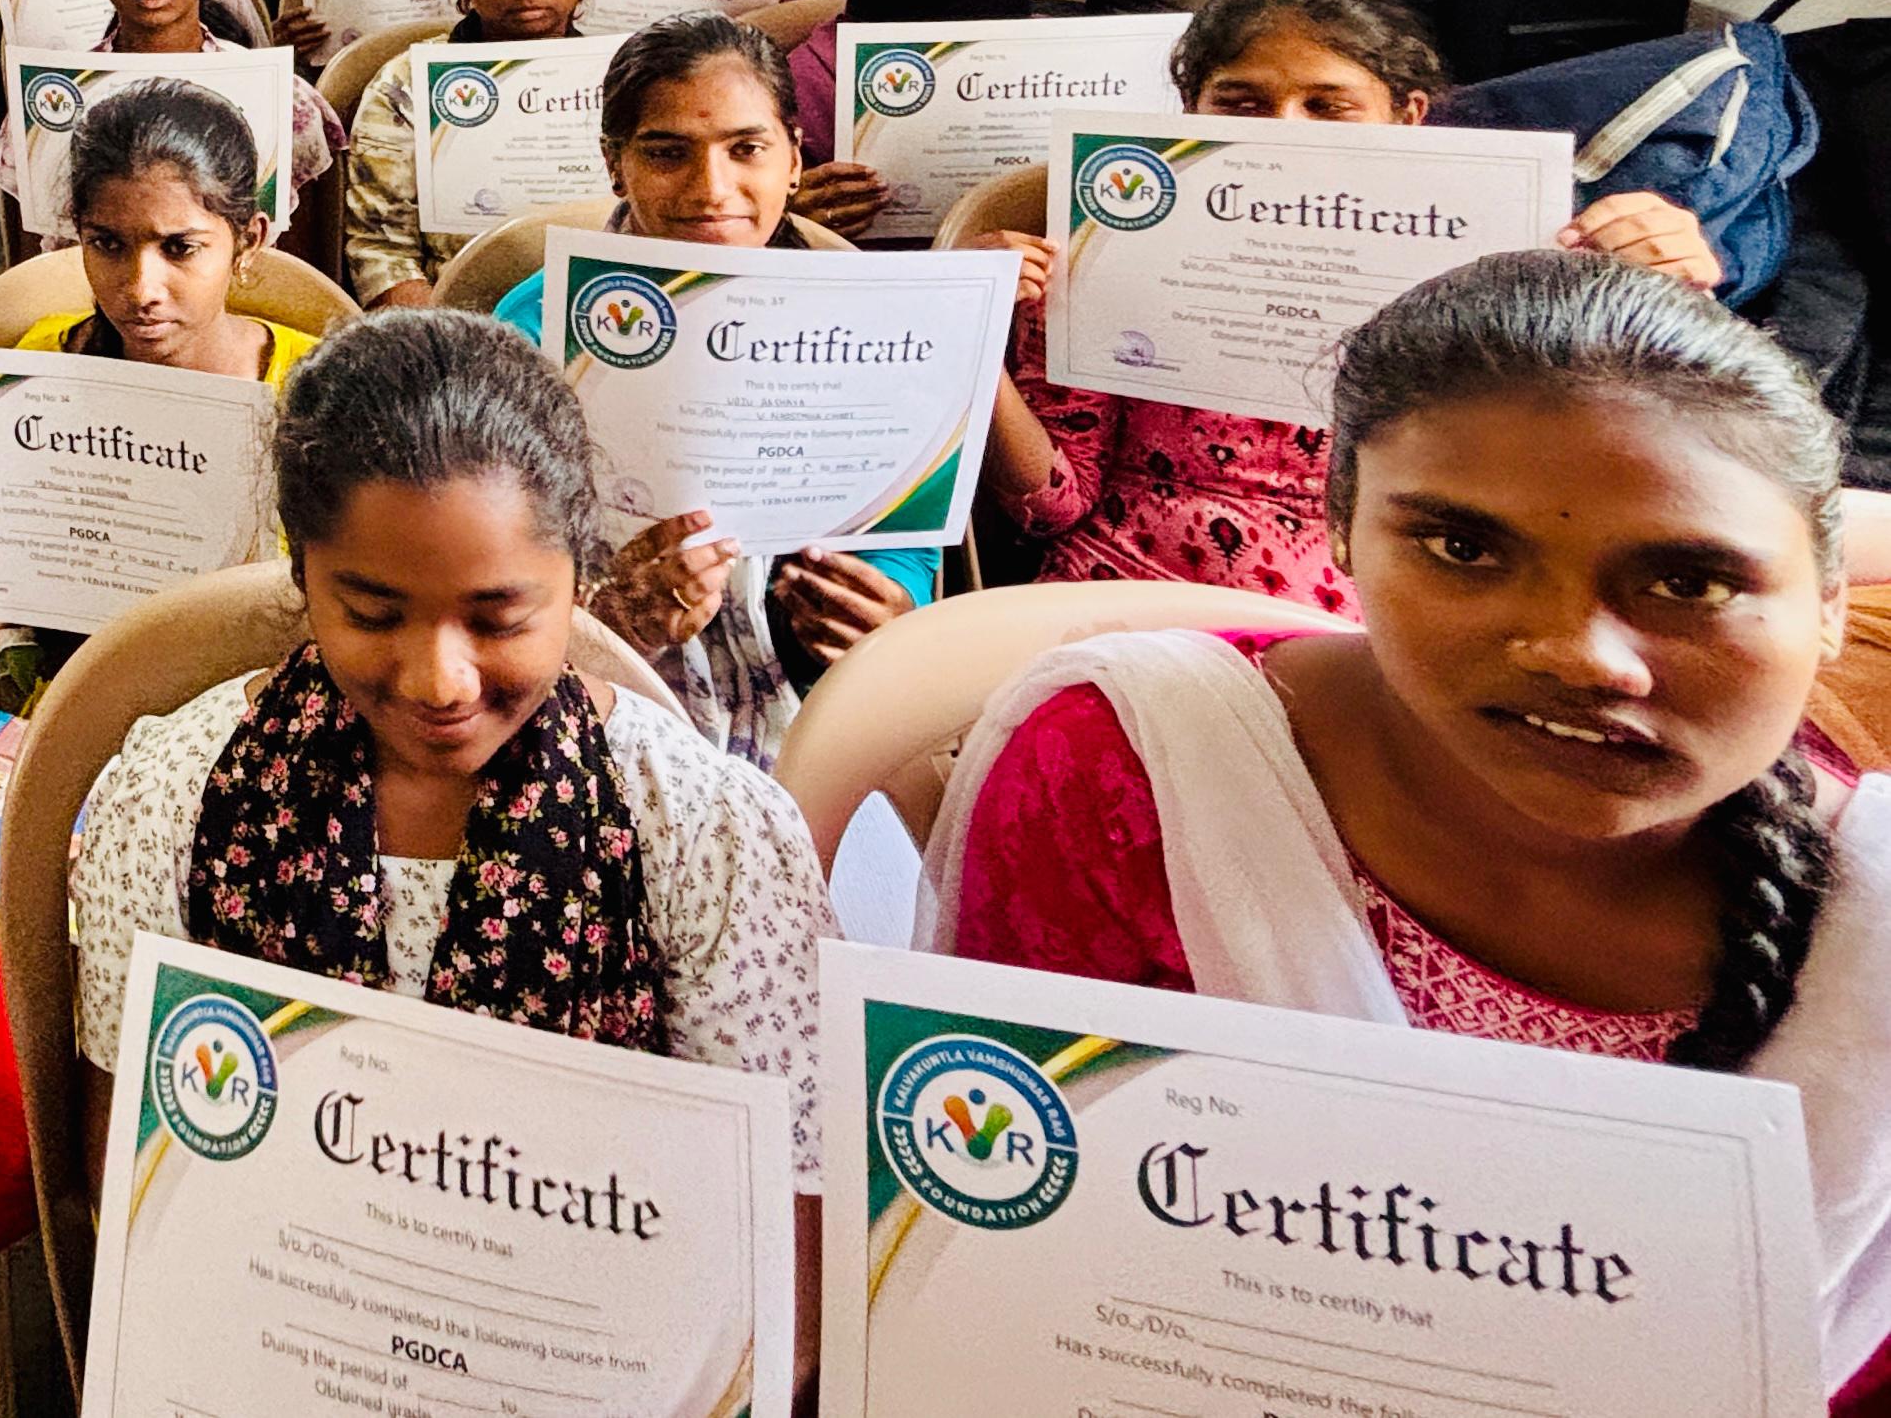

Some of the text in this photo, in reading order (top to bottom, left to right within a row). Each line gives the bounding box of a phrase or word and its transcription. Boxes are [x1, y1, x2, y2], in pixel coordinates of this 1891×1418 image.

[957, 70, 1127, 102] Certificate
[995, 156, 1031, 166] PGDCA
[1206, 183, 1469, 239] Certificate
[1266, 304, 1321, 320] PGDCA
[706, 320, 934, 364] Certificate
[745, 380, 764, 390] This
[778, 381, 788, 390] to
[14, 414, 208, 474] Certificate
[758, 446, 804, 457] PGDCA
[50, 466, 66, 477] This
[77, 469, 86, 478] to
[70, 527, 110, 542] PGDCA
[338, 1045, 367, 1068] Reg
[892, 1049, 1067, 1138] KALVAKUNTLA VAMSHIDHAR RAO
[1165, 1087, 1243, 1117] Reg No:
[314, 1089, 662, 1241] Certificate
[921, 1178, 1043, 1222] FOUNDATION
[365, 1201, 513, 1258] This is to certify that
[1136, 1141, 1635, 1304] Certificate
[249, 1255, 647, 1374] Has successfully completed the following course from
[1222, 1269, 1434, 1329] This is to certify that
[262, 1330, 308, 1365] During
[313, 1347, 336, 1371] the
[340, 1356, 387, 1391] period
[393, 1372, 408, 1390] of
[391, 1334, 468, 1374] PGDCA
[1055, 1333, 1092, 1358] Has
[1097, 1345, 1213, 1386] successfully
[1221, 1373, 1333, 1412] completed
[1338, 1392, 1373, 1418] the
[315, 1378, 383, 1414] Obtained
